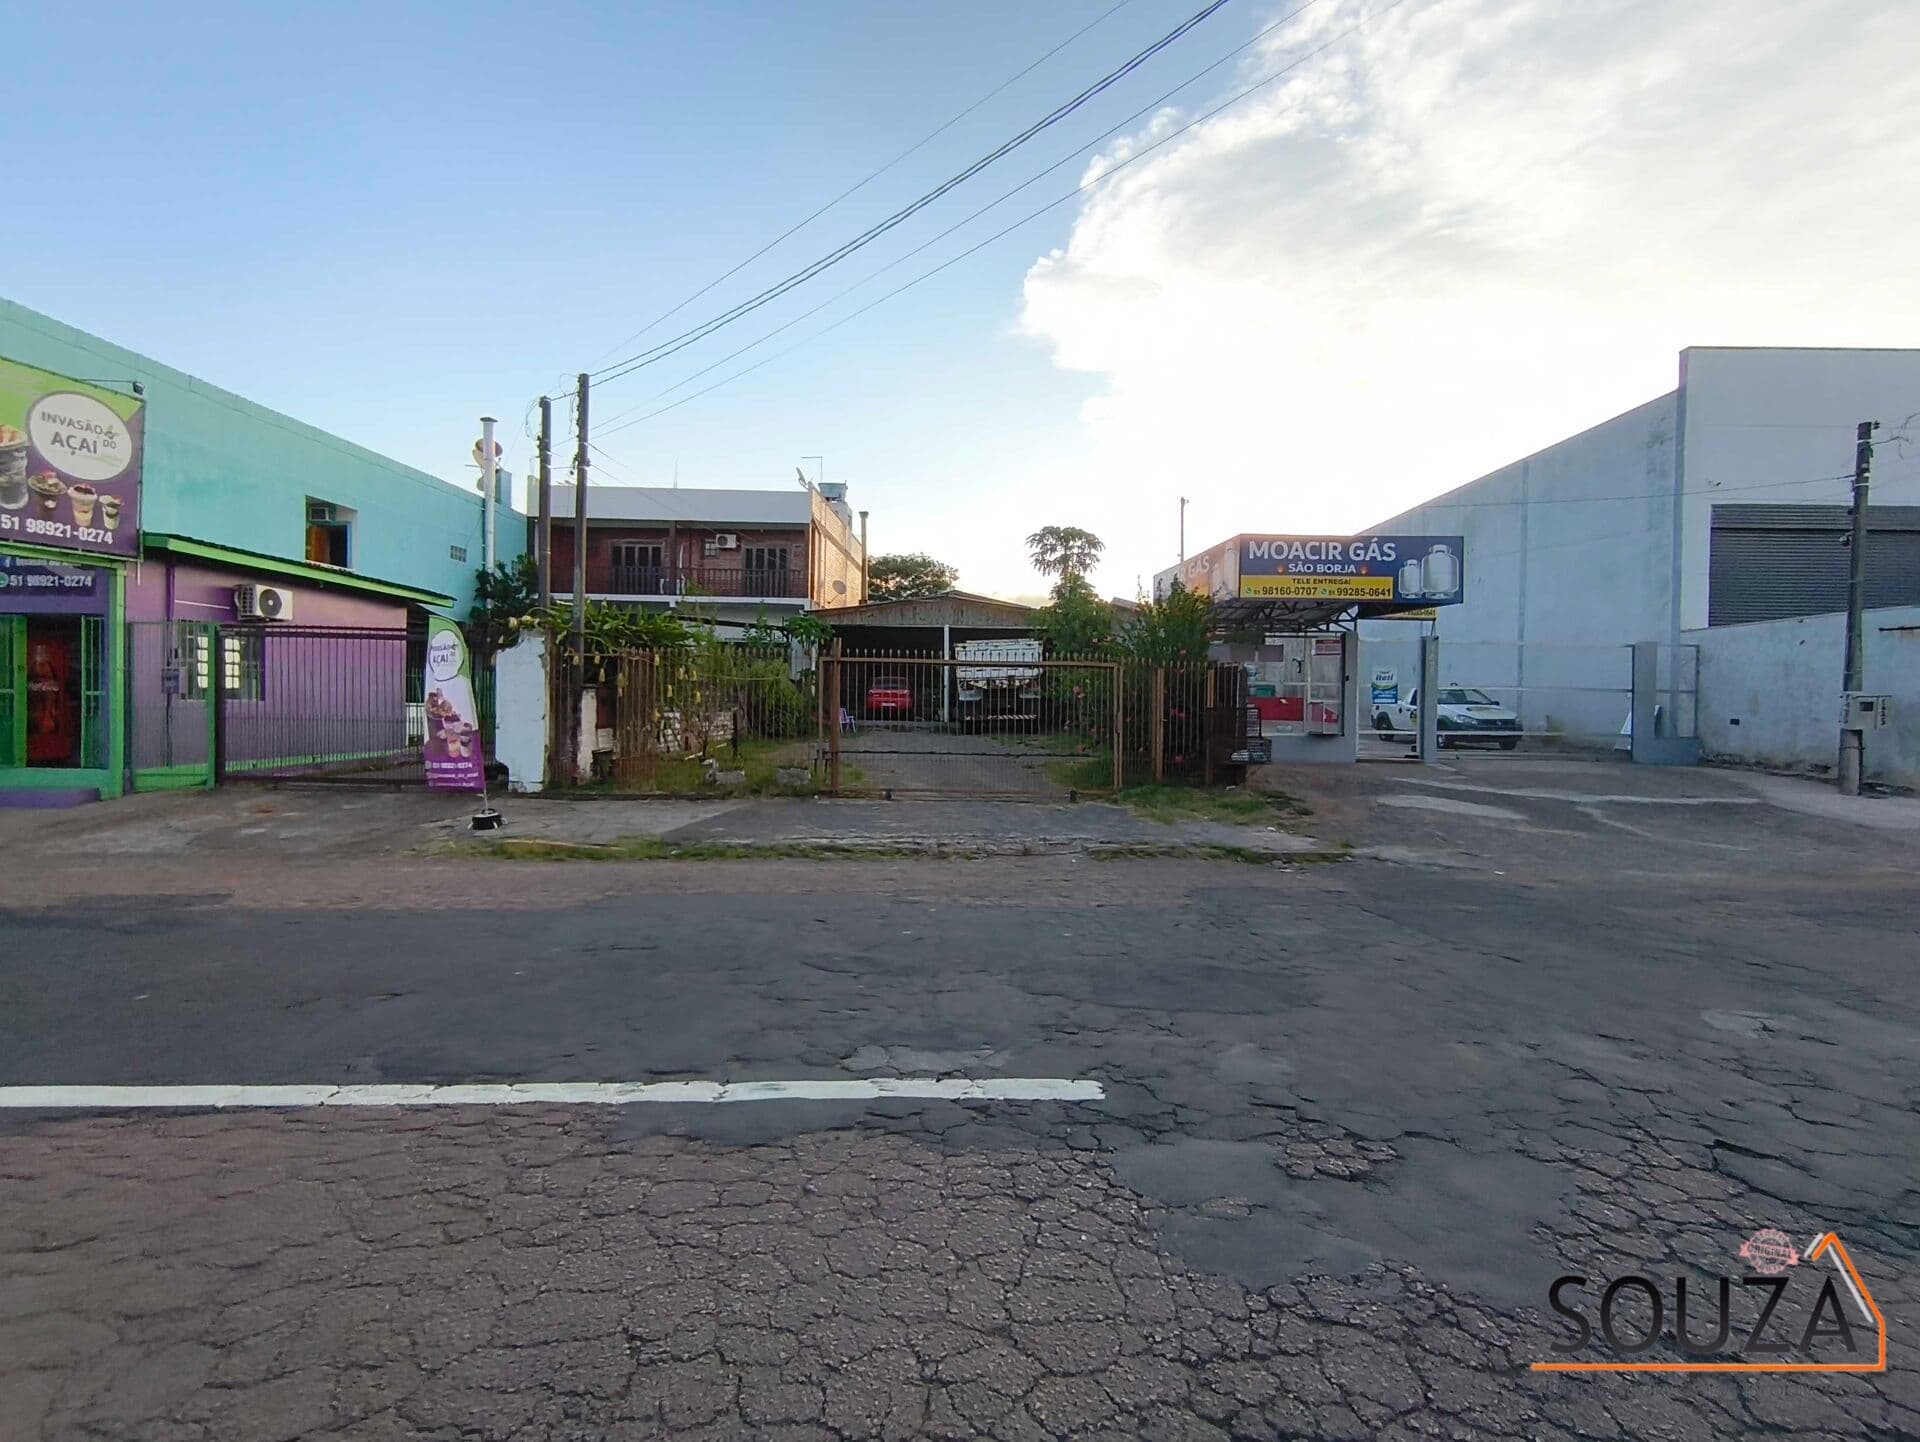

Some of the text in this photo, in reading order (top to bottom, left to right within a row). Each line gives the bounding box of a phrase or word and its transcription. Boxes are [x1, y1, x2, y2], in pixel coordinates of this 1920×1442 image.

[41, 411, 103, 436] INVASÃO
[1, 513, 113, 545] 51 98921-0274
[1249, 537, 1396, 561] MOACIR GÁS
[1288, 561, 1357, 574] SÃO BORJA
[1262, 586, 1318, 596] 98160-0707
[1336, 587, 1391, 597] 99285-0641
